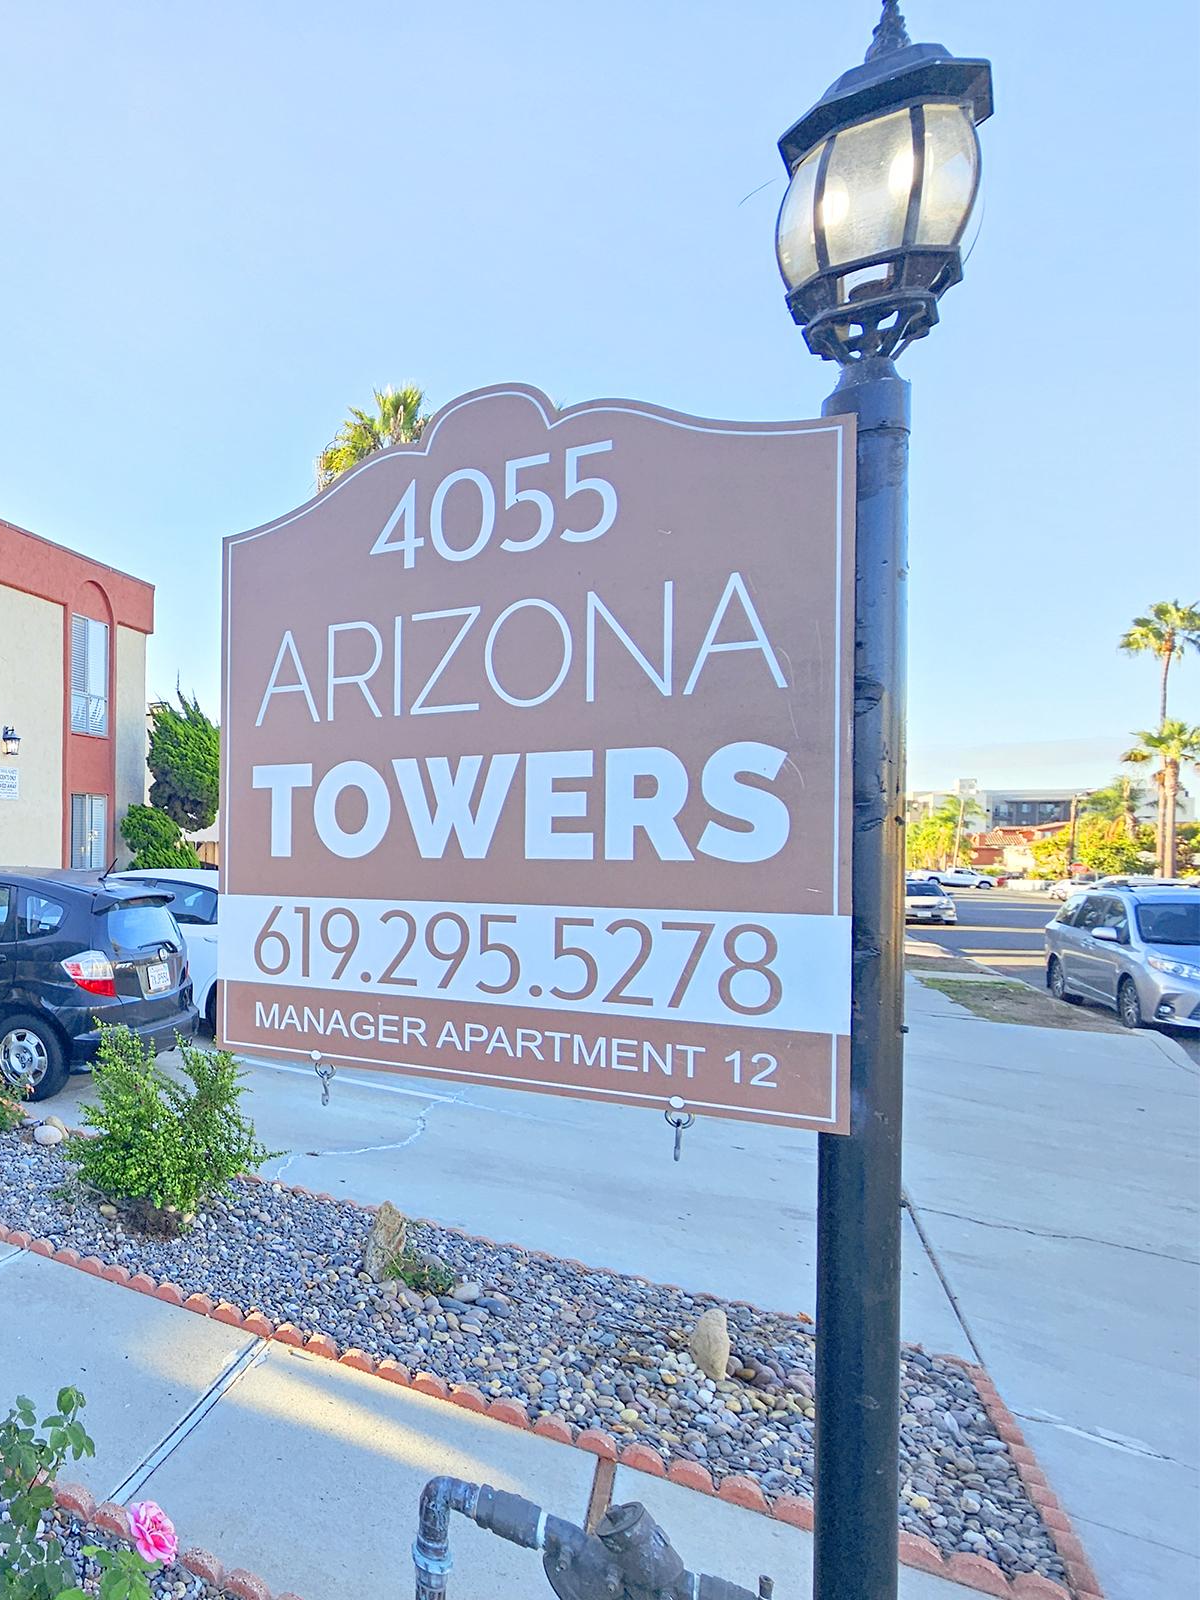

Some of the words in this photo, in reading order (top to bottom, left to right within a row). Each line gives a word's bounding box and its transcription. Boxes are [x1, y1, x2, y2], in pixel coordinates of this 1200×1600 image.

[370, 440, 618, 568] 4055
[255, 572, 788, 727] ARIZONA
[252, 741, 790, 863] TOWERS
[253, 906, 783, 1016] 619.295.5278
[255, 1001, 427, 1047] MANAGER
[436, 1021, 706, 1079] APARTMENT
[726, 1051, 779, 1088] 12
